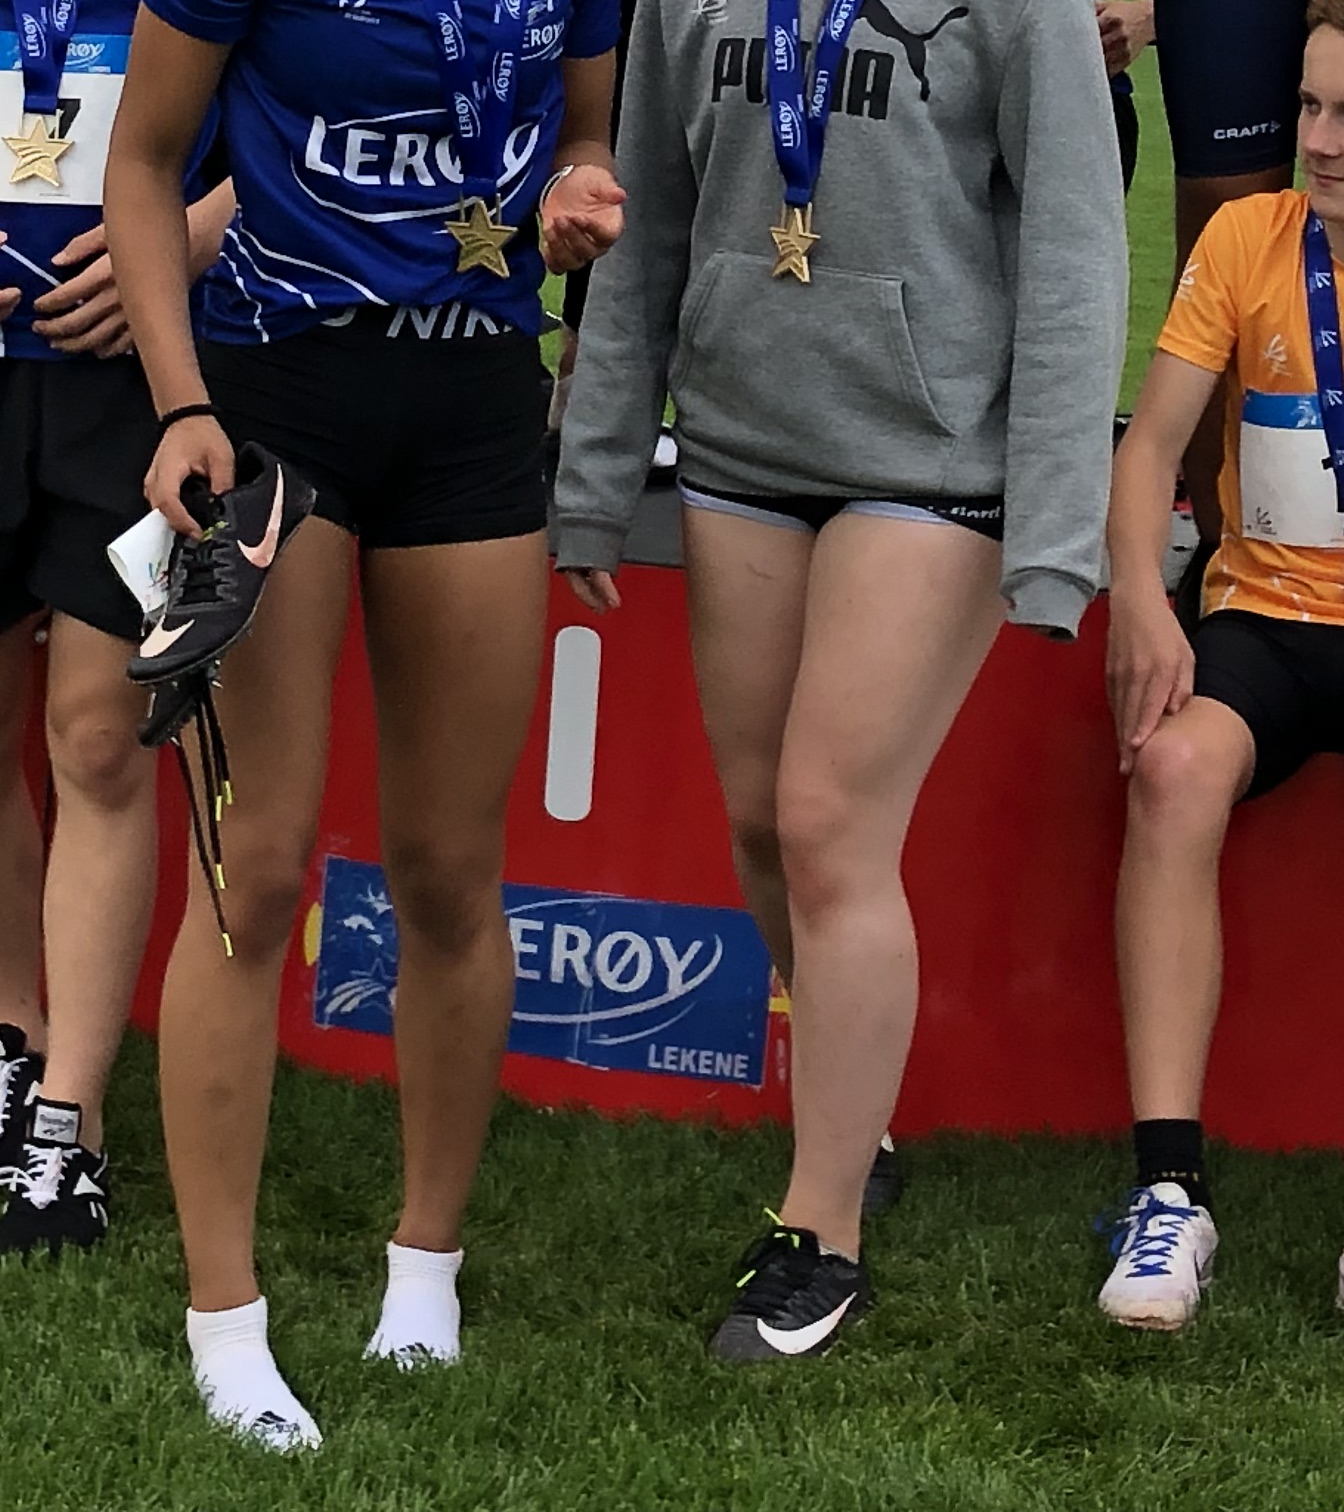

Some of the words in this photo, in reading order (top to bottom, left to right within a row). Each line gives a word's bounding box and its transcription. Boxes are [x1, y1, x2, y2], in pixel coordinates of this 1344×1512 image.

[67, 42, 105, 58] RØY
[1214, 124, 1267, 140] CRAFT
[386, 301, 512, 338] NIK
[509, 918, 702, 993] ERØY
[648, 1044, 749, 1079] LEKENE
